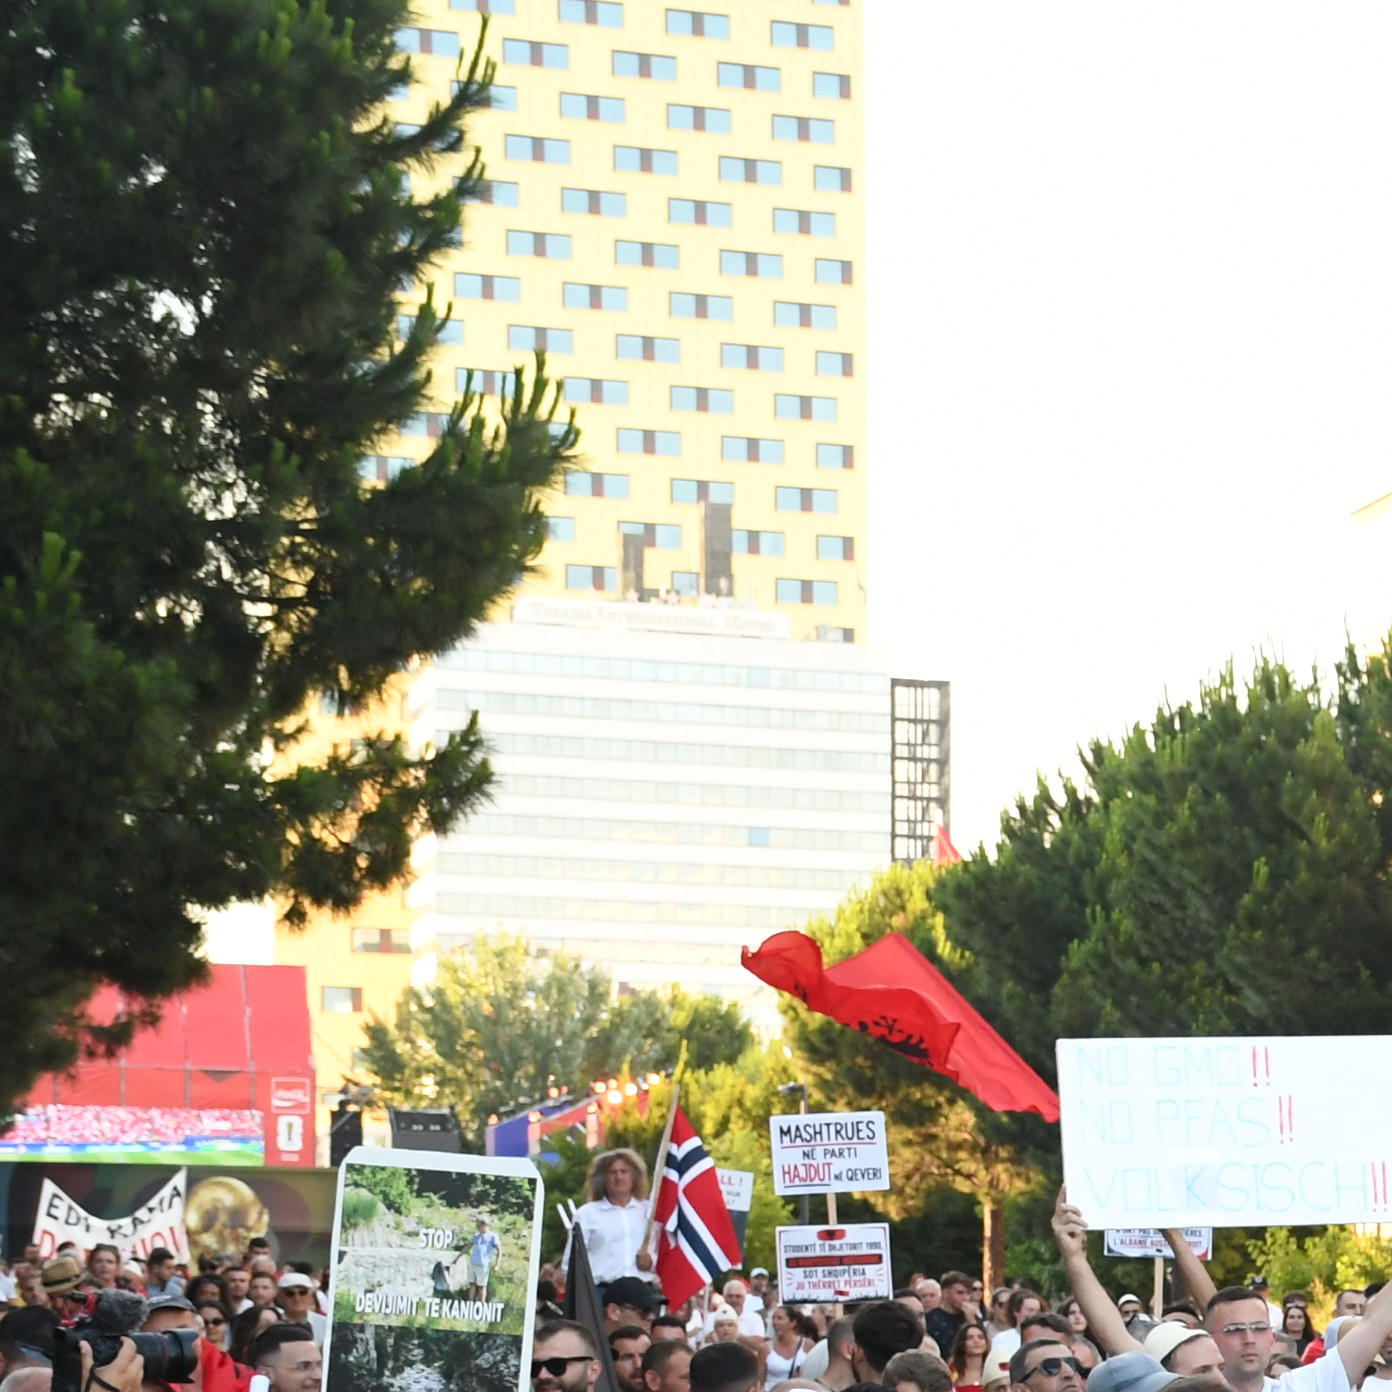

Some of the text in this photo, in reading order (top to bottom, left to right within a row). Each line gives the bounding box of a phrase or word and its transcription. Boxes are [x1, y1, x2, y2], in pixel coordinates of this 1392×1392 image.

[1077, 1046, 1130, 1087] NO
[779, 1120, 877, 1145] MASHTRUES
[1080, 1099, 1134, 1146] NO
[823, 1147, 858, 1160] PARTI
[782, 1162, 833, 1185] HAJDUT
[845, 1167, 882, 1182] QEVERI
[418, 1227, 454, 1249] STOP
[803, 1268, 818, 1280] SOT
[423, 1298, 440, 1319] TE
[442, 1299, 505, 1323] KANIONIT
